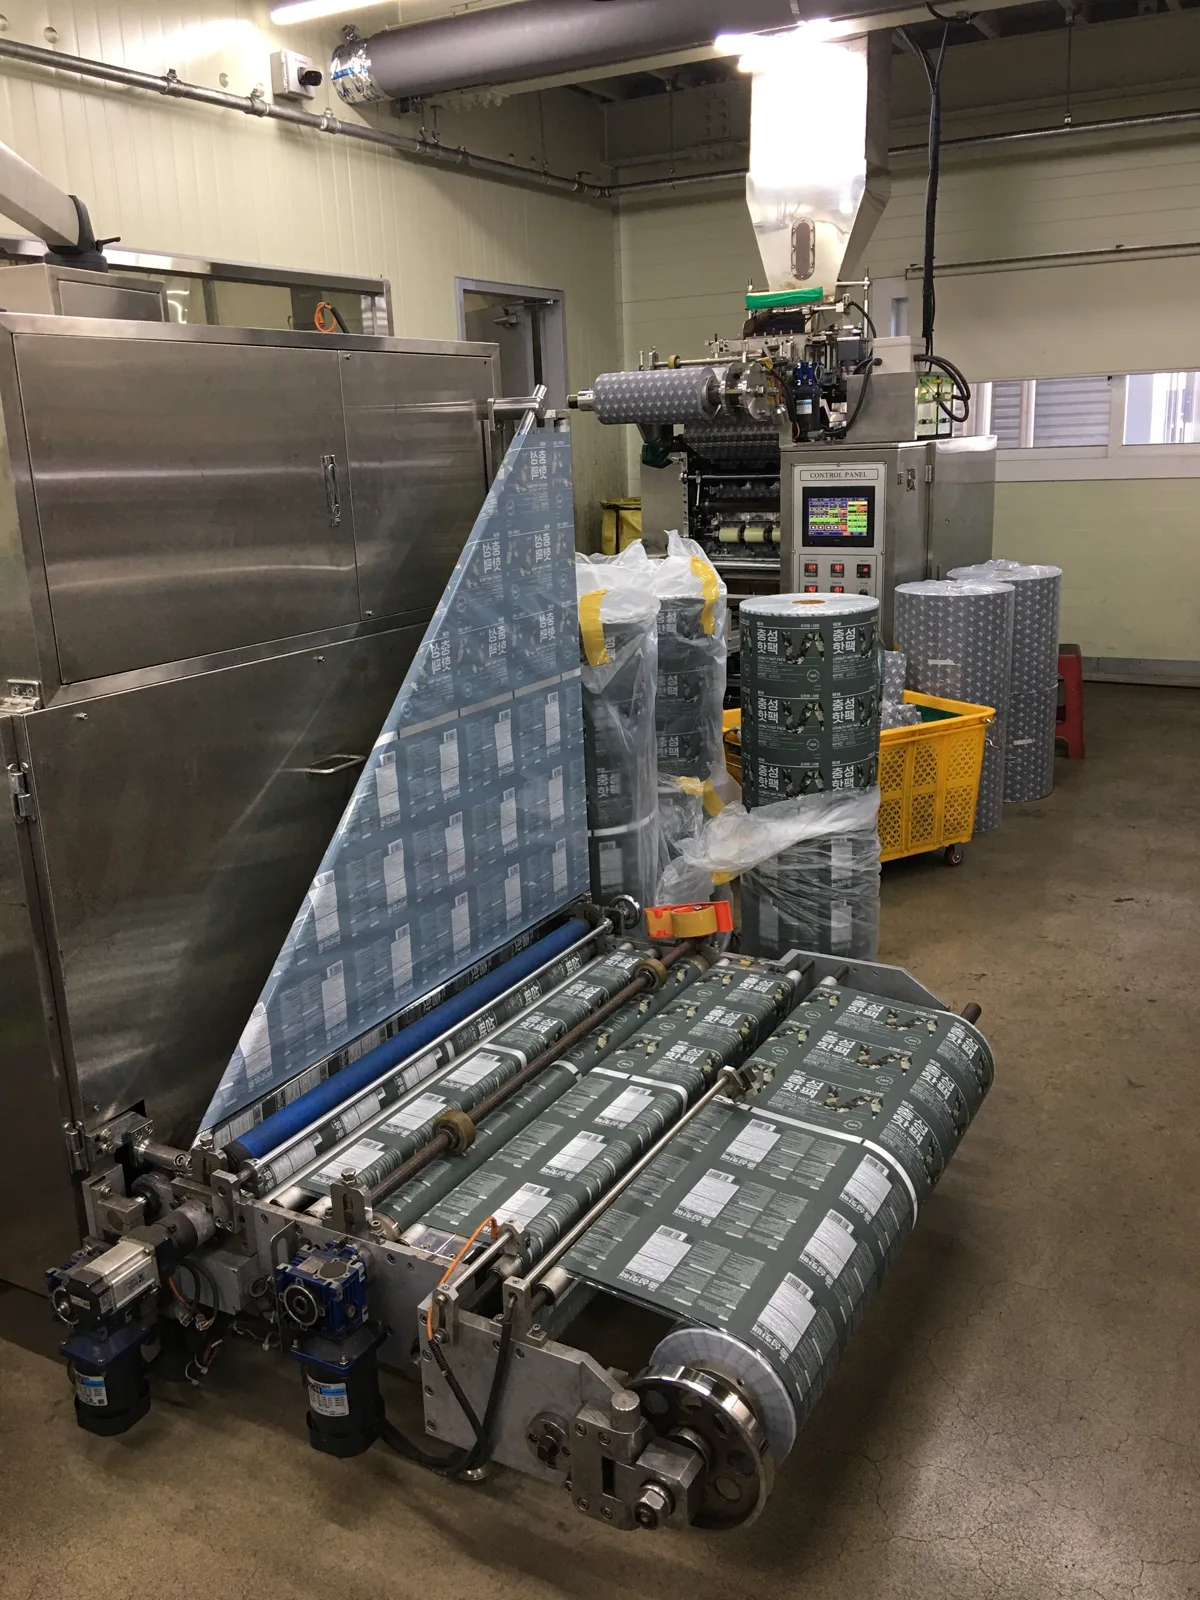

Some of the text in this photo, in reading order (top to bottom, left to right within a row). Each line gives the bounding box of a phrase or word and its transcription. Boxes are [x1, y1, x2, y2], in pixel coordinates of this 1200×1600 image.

[757, 629, 778, 642] 충성
[832, 627, 856, 641] 충성
[757, 642, 778, 655] 핫팩
[832, 640, 856, 654] 핫팩
[757, 698, 778, 711] 충성
[832, 697, 855, 711] 충성
[757, 711, 779, 724] 핫팩
[832, 710, 855, 724] 핫팩
[758, 765, 779, 778] 충성
[831, 764, 855, 779] 충성
[758, 778, 779, 791] 핫팩
[831, 777, 855, 791] 핫팩
[737, 982, 769, 993] 핫팩
[743, 977, 775, 987] 충성
[845, 1005, 879, 1019] 핫팩
[850, 999, 884, 1012] 충성
[701, 1015, 736, 1027] 핫팩
[709, 1009, 742, 1020] 충성
[821, 1034, 856, 1048] 충성
[946, 1032, 975, 1060] 핫팩
[950, 1026, 979, 1052] 충성
[670, 1044, 705, 1057] 충성
[815, 1041, 851, 1056] 핫팩
[662, 1051, 698, 1064] 핫팩
[787, 1073, 825, 1090] 충성
[925, 1061, 955, 1092] 충성
[780, 1081, 819, 1099] 핫팩
[920, 1069, 951, 1100] 핫팩
[896, 1105, 929, 1137] 충성
[891, 1113, 924, 1146] 핫팩
